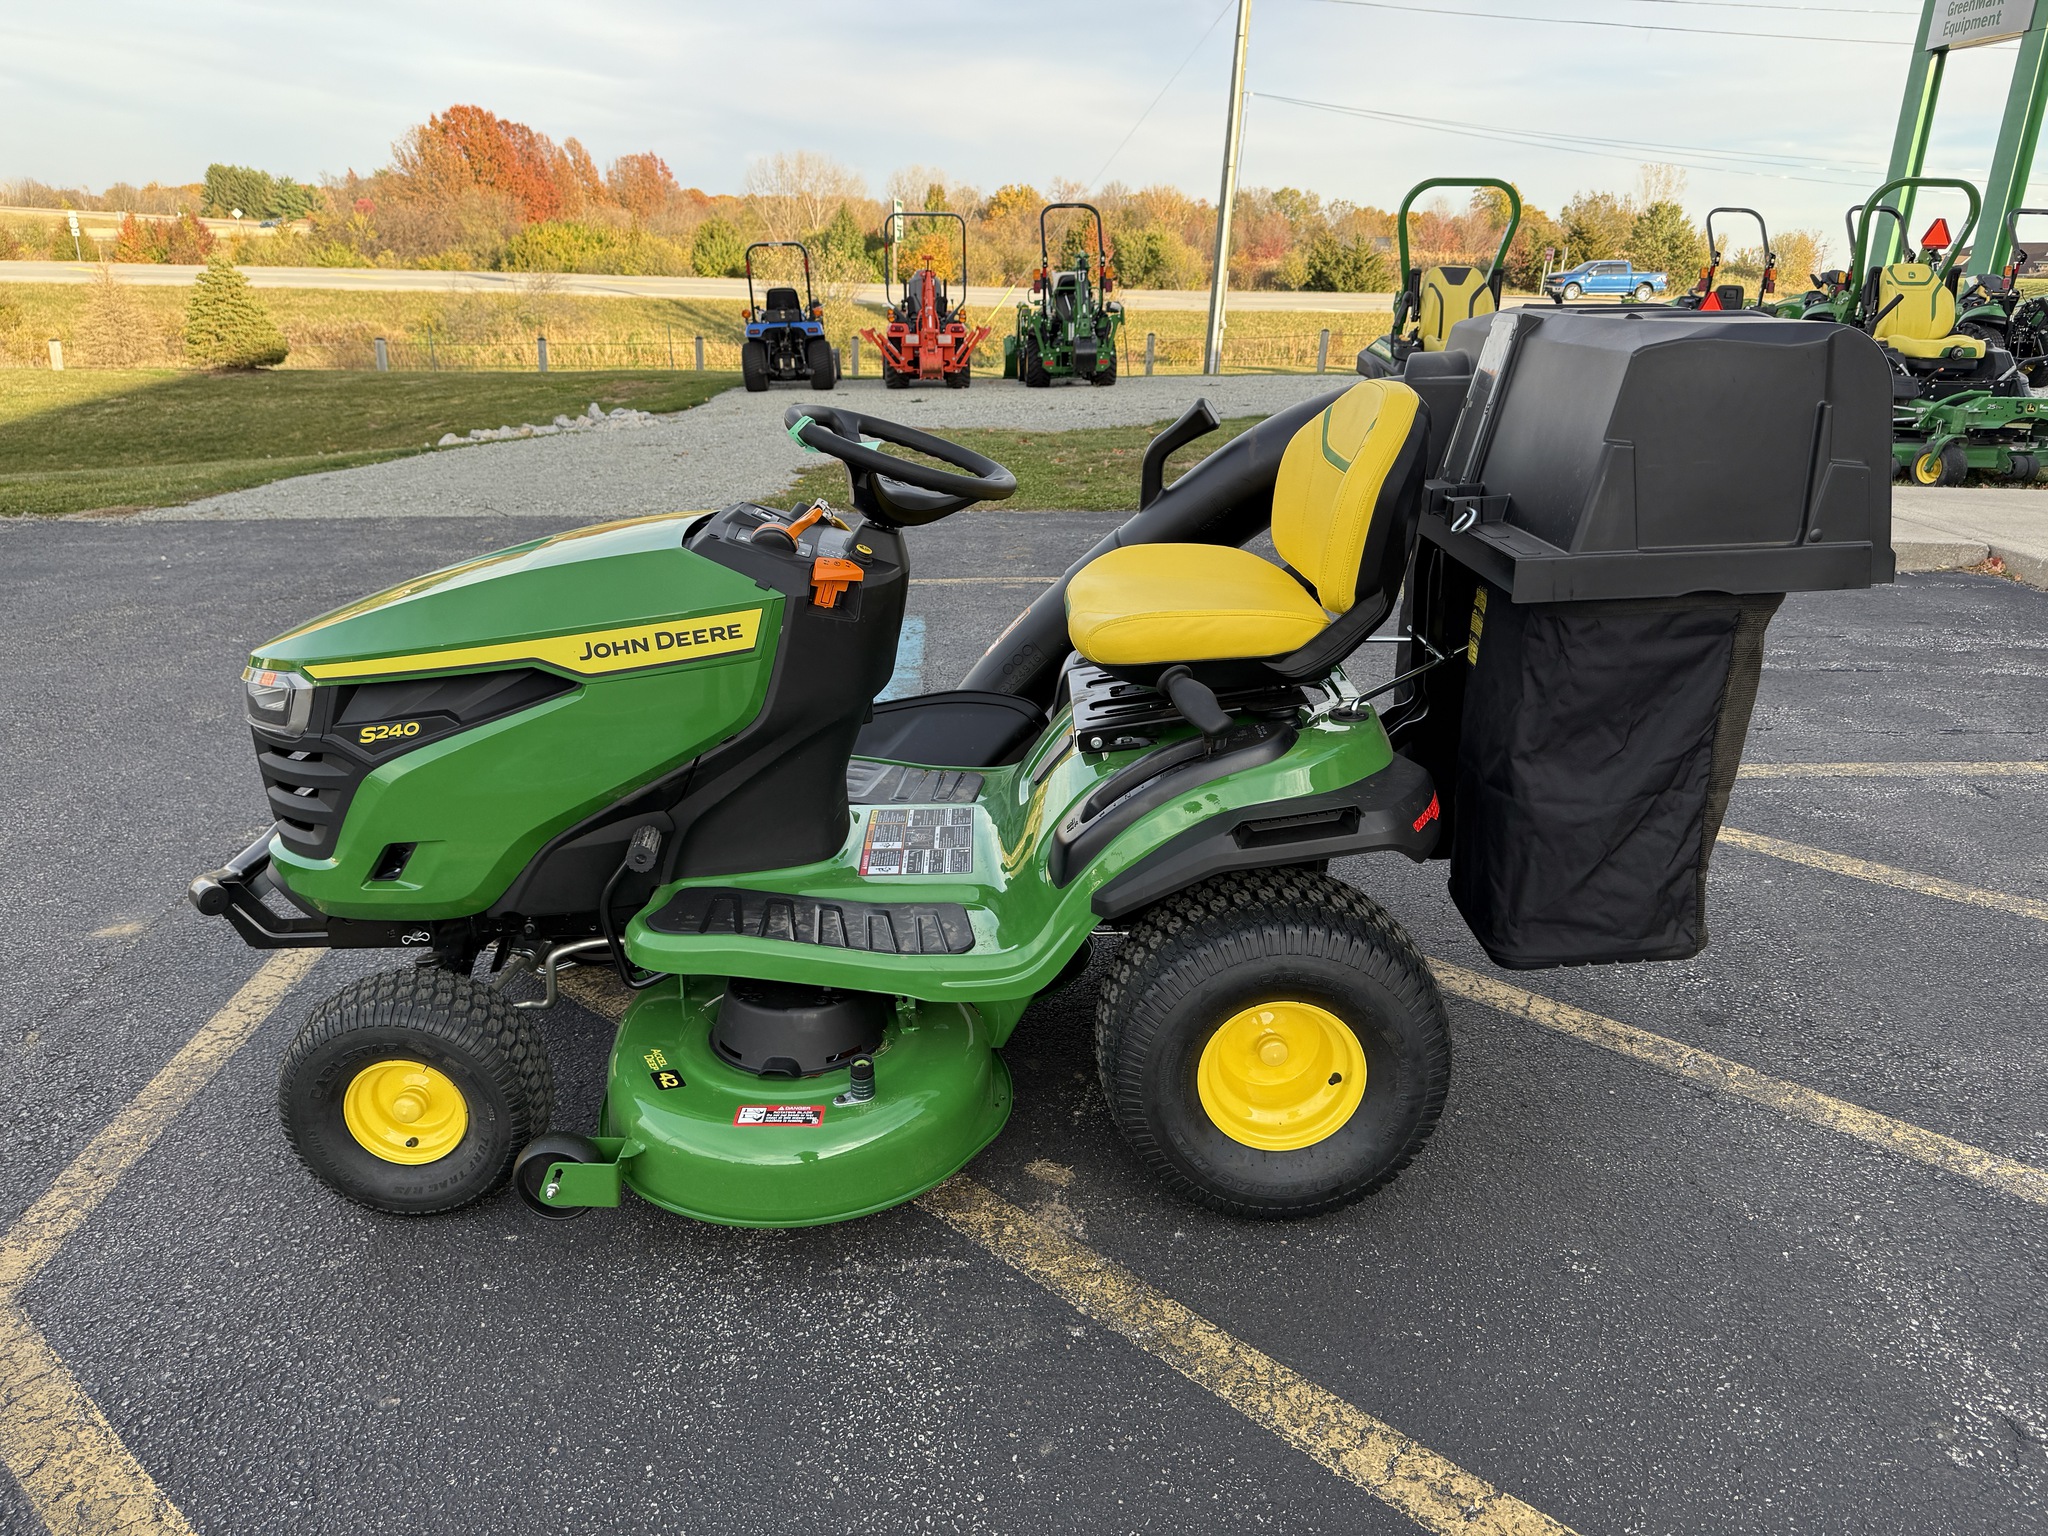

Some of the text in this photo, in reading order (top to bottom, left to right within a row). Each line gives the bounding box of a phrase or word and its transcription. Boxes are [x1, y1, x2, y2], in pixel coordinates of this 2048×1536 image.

[1943, 10, 2002, 37] Equipment
[579, 624, 743, 661] JOHN DEERE
[360, 722, 420, 744] S240
[643, 1054, 660, 1070] DEEP
[659, 1072, 679, 1088] 42
[470, 1137, 489, 1172] TURF
[428, 1170, 467, 1193] TRAC
